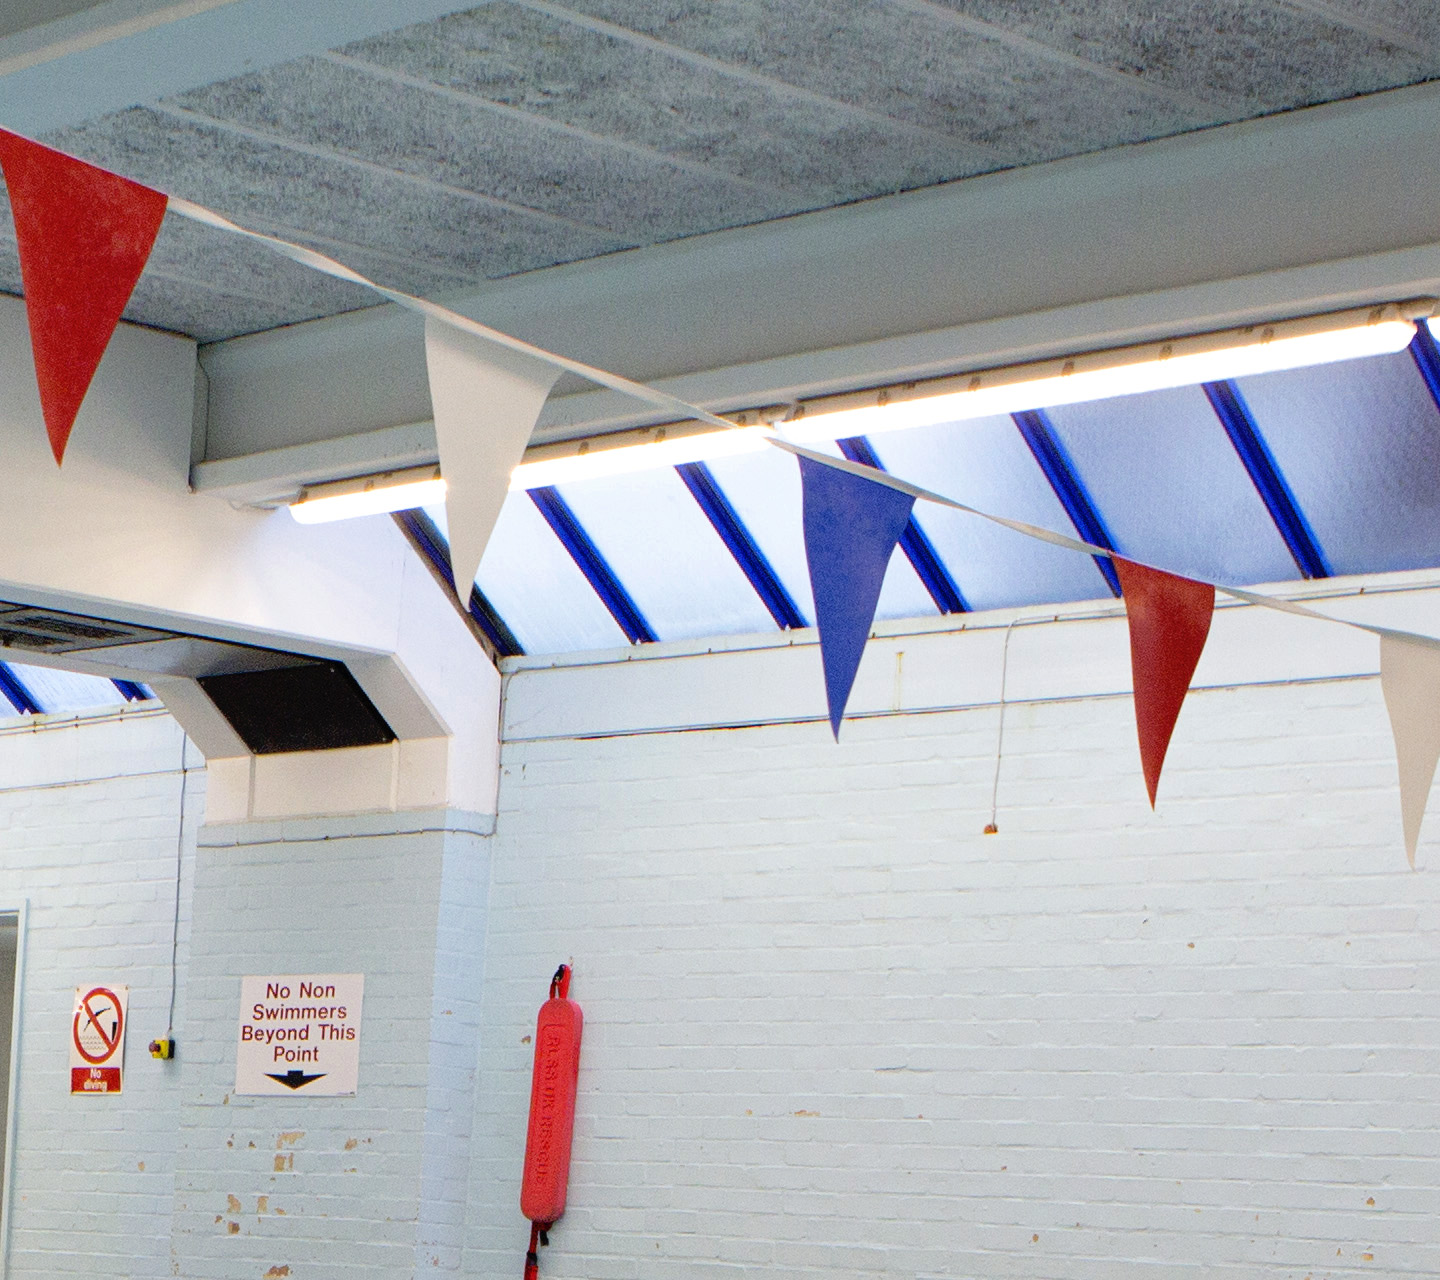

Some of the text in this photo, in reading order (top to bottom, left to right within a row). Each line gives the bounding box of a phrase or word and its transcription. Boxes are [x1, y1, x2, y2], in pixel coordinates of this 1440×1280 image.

[266, 982, 336, 999] No Non
[252, 1004, 347, 1021] Swimmers
[241, 1024, 356, 1045] Beyond This
[273, 1046, 319, 1062] Point
[90, 1068, 102, 1079] No
